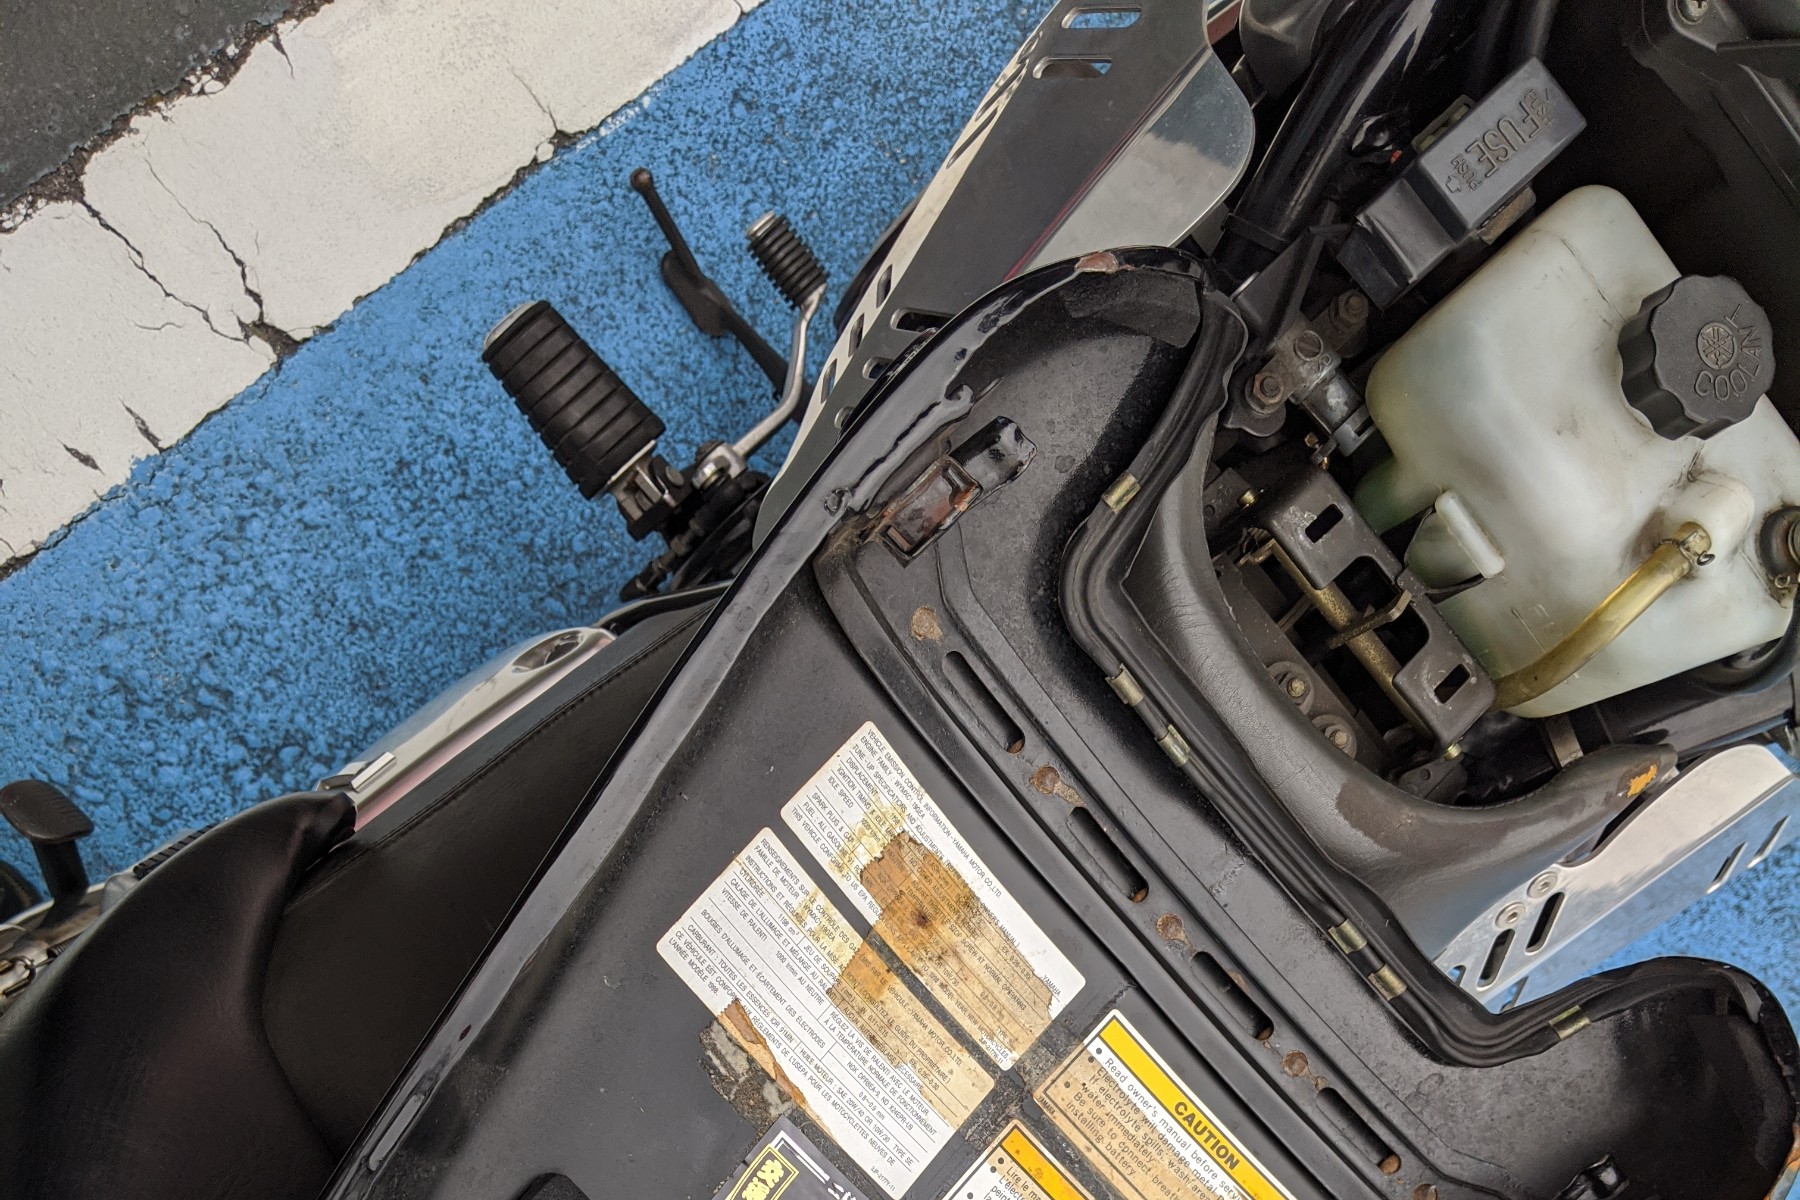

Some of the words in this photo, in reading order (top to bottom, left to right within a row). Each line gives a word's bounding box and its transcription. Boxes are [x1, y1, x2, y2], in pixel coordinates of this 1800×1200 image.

[1464, 101, 1542, 178] FUSE
[1694, 303, 1765, 402] COOLANT
[845, 758, 877, 796] DISPLACEMENT
[859, 737, 877, 757] ENGINE
[875, 757, 892, 778] FAMILY
[866, 730, 885, 752] VEHICLE
[884, 752, 905, 778] EMISSION
[922, 802, 951, 836] INFORMATION
[968, 858, 985, 878] MOTOR
[720, 889, 740, 910] VITESSE
[1096, 1067, 1141, 1115] Electrolyte
[1156, 1132, 1190, 1167] damage
[1192, 1167, 1216, 1193] metal
[1097, 1085, 1142, 1132] electrolyte
[1104, 1058, 1127, 1083] Read
[1126, 1083, 1159, 1117] owner's
[1159, 1116, 1190, 1150] manual
[1191, 1150, 1219, 1180] before
[1173, 1100, 1240, 1170] CAUTION
[1006, 1167, 1021, 1182] Lire
[1020, 1181, 1029, 1191] le
